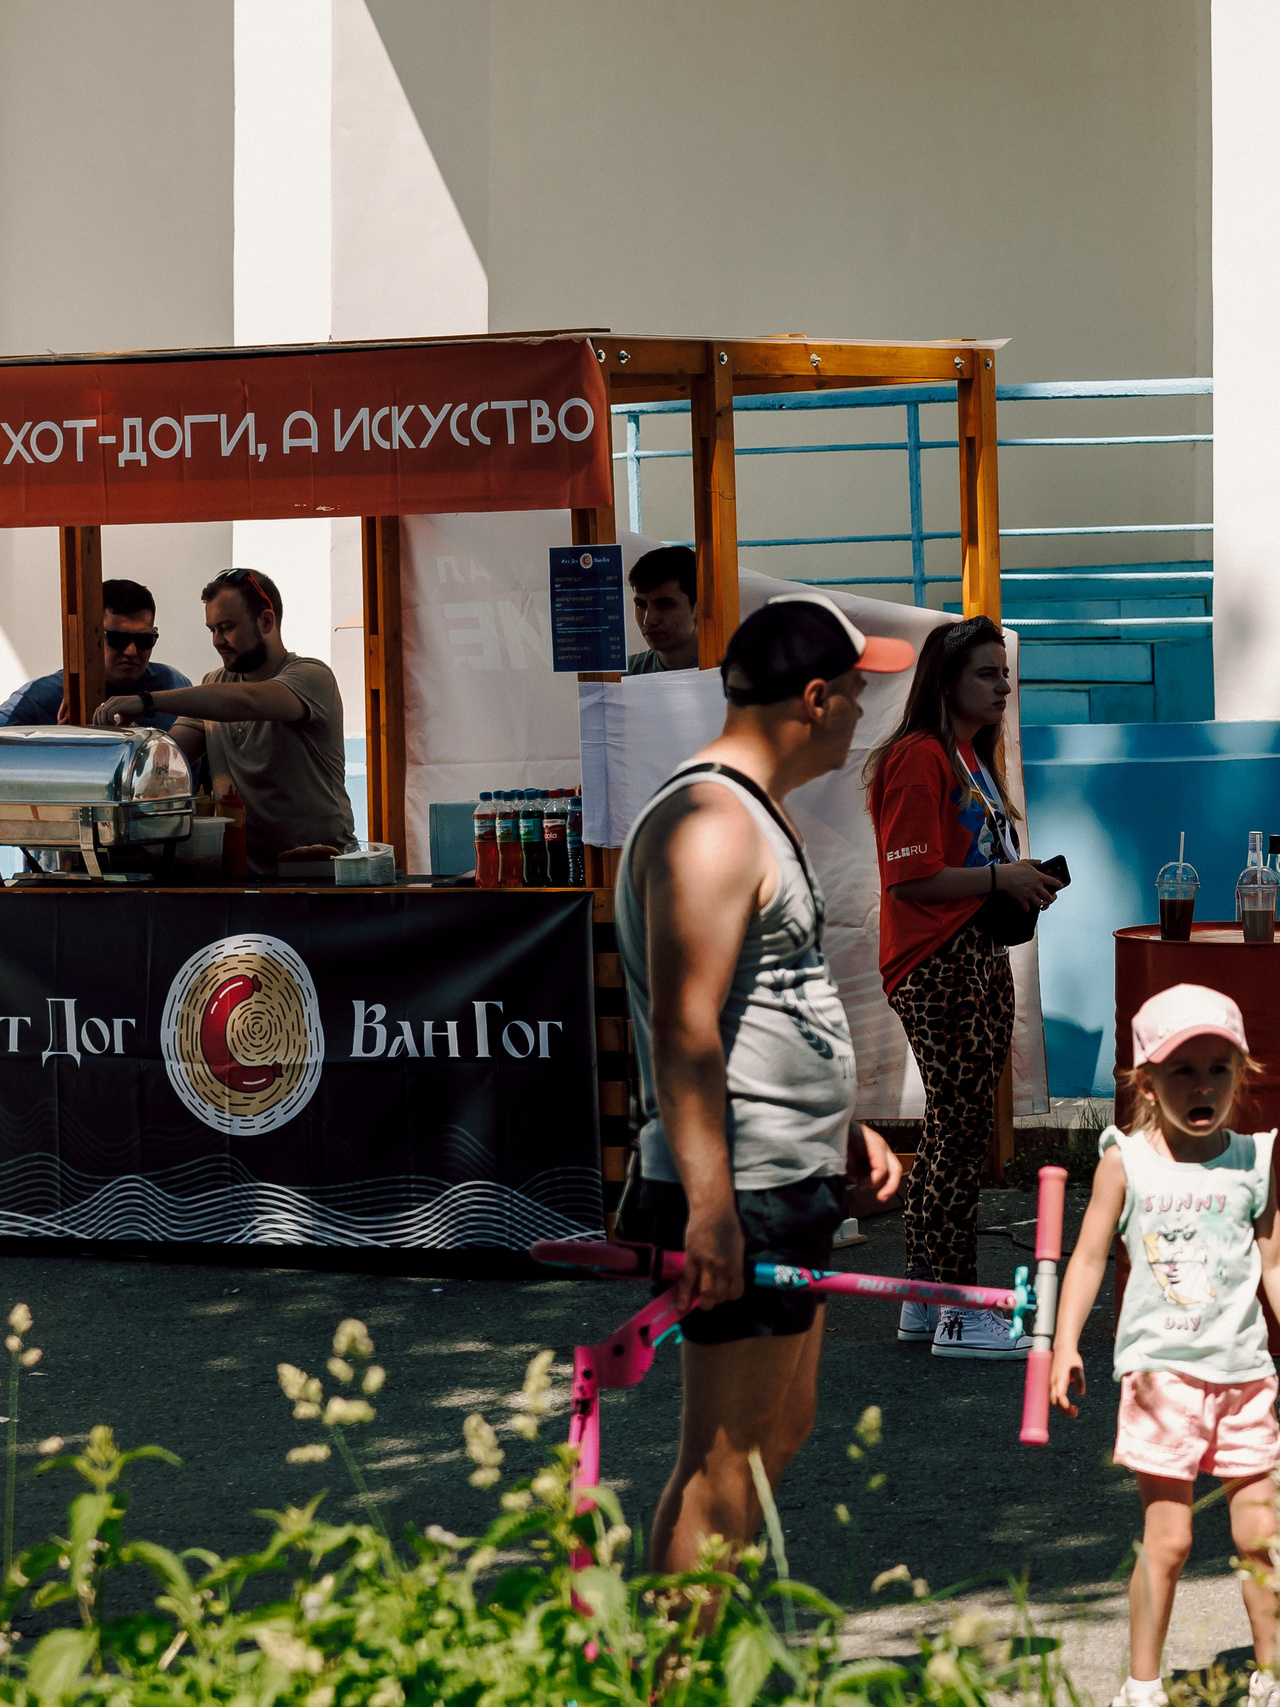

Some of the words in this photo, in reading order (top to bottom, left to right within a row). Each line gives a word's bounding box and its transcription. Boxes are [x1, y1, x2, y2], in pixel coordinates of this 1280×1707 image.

[0, 411, 268, 468] ХОТ-ДОГИ,
[282, 410, 319, 454] А
[333, 397, 596, 452] ИСКУССТВО
[42, 998, 136, 1068] Дог
[1145, 1193, 1227, 1213] SUNNY
[857, 1278, 909, 1295] RUSH
[1164, 1316, 1201, 1332] DAY
